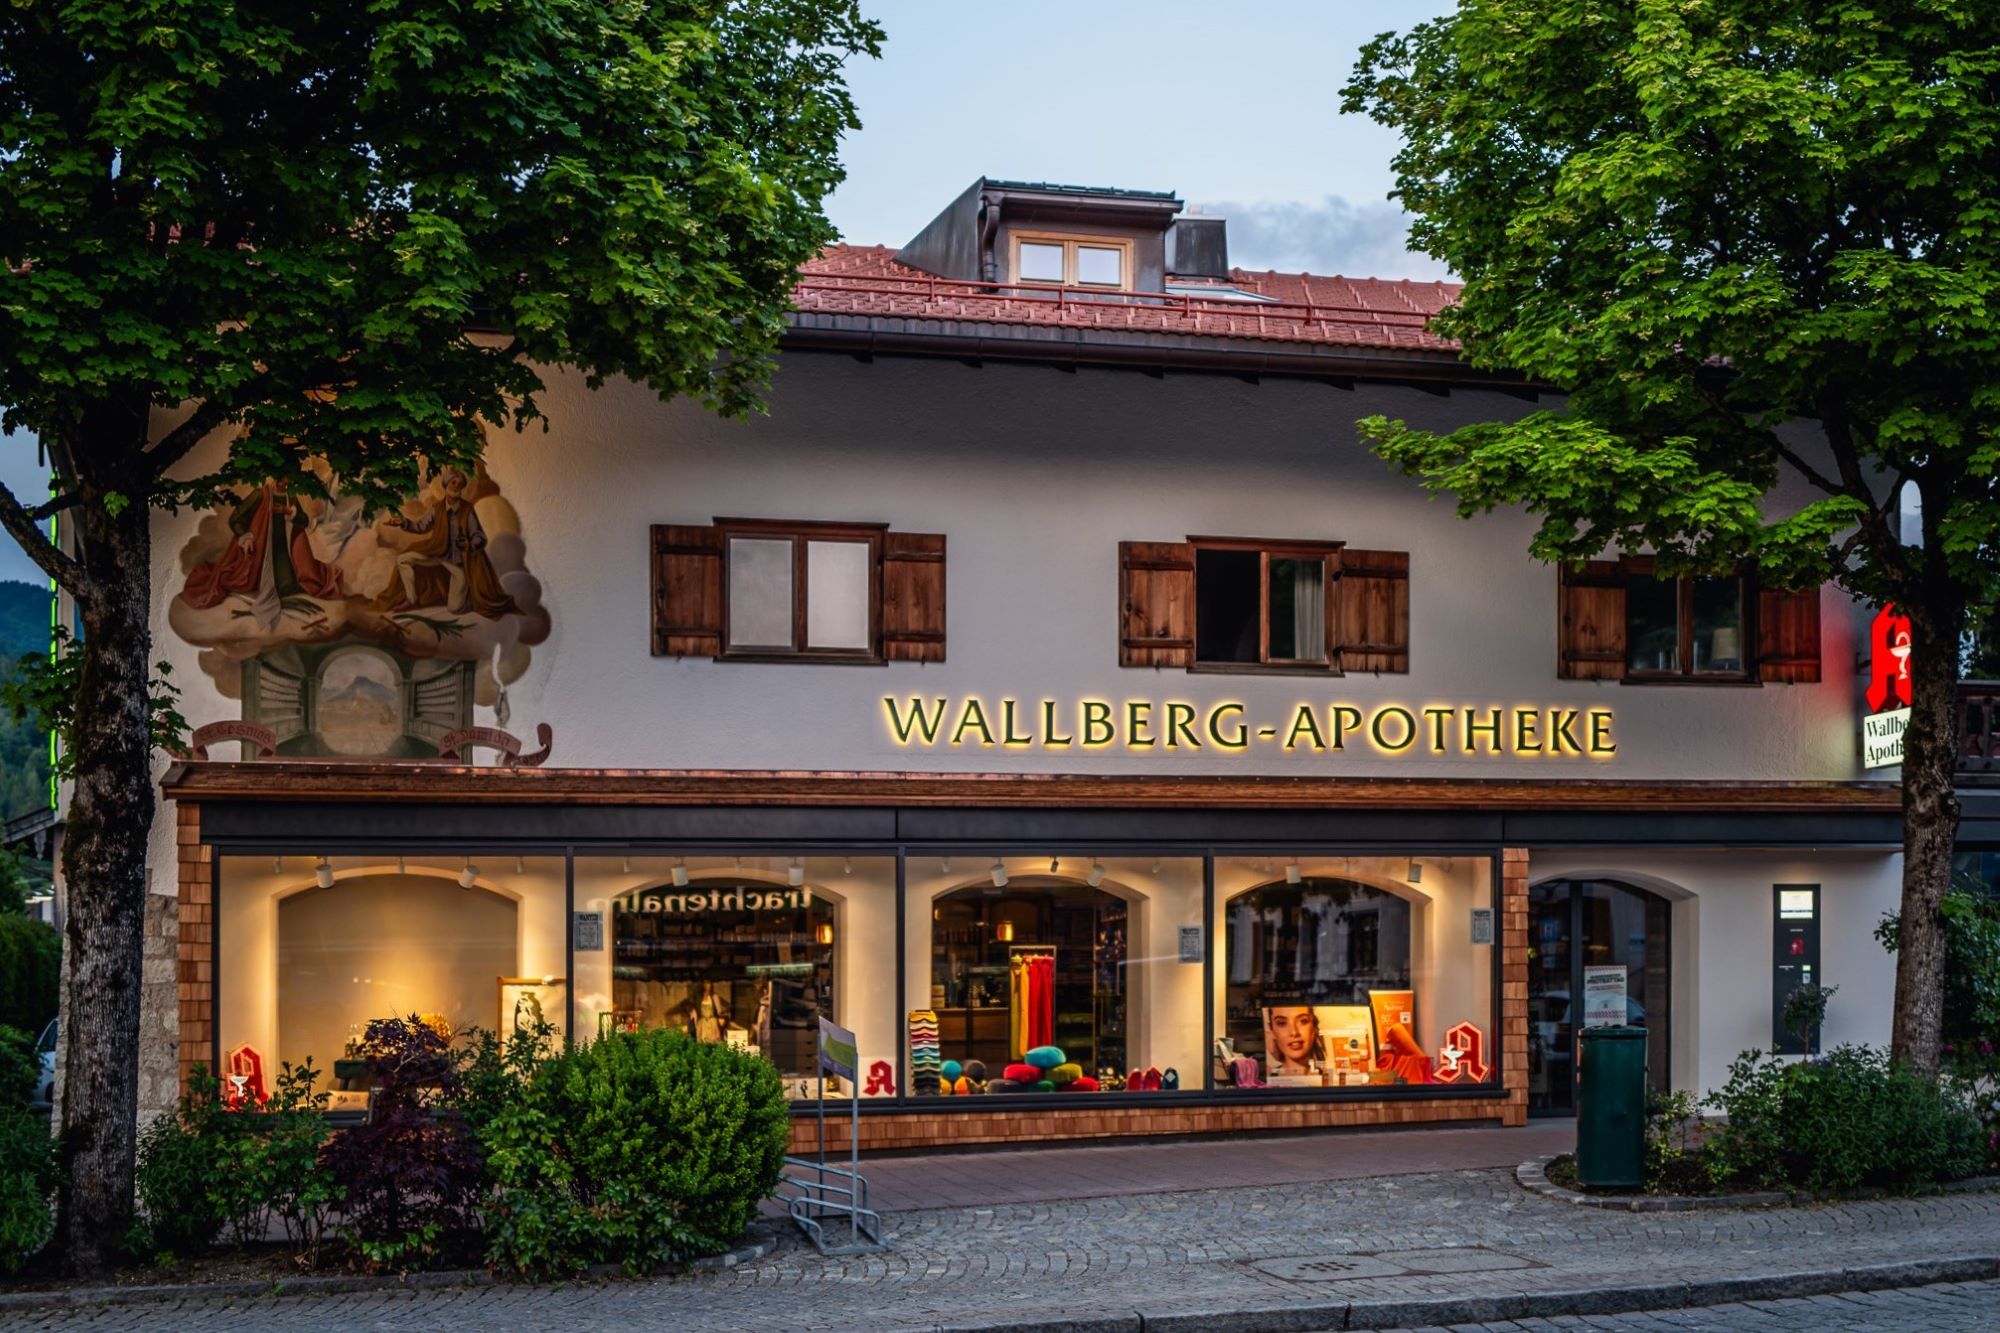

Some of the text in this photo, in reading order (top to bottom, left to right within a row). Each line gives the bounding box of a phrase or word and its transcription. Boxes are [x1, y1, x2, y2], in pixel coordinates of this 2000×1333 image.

[883, 697, 1618, 755] WALLBERG-APOTHEKE
[1866, 715, 1910, 737] Wallbe
[1866, 738, 1904, 765] Apoth
